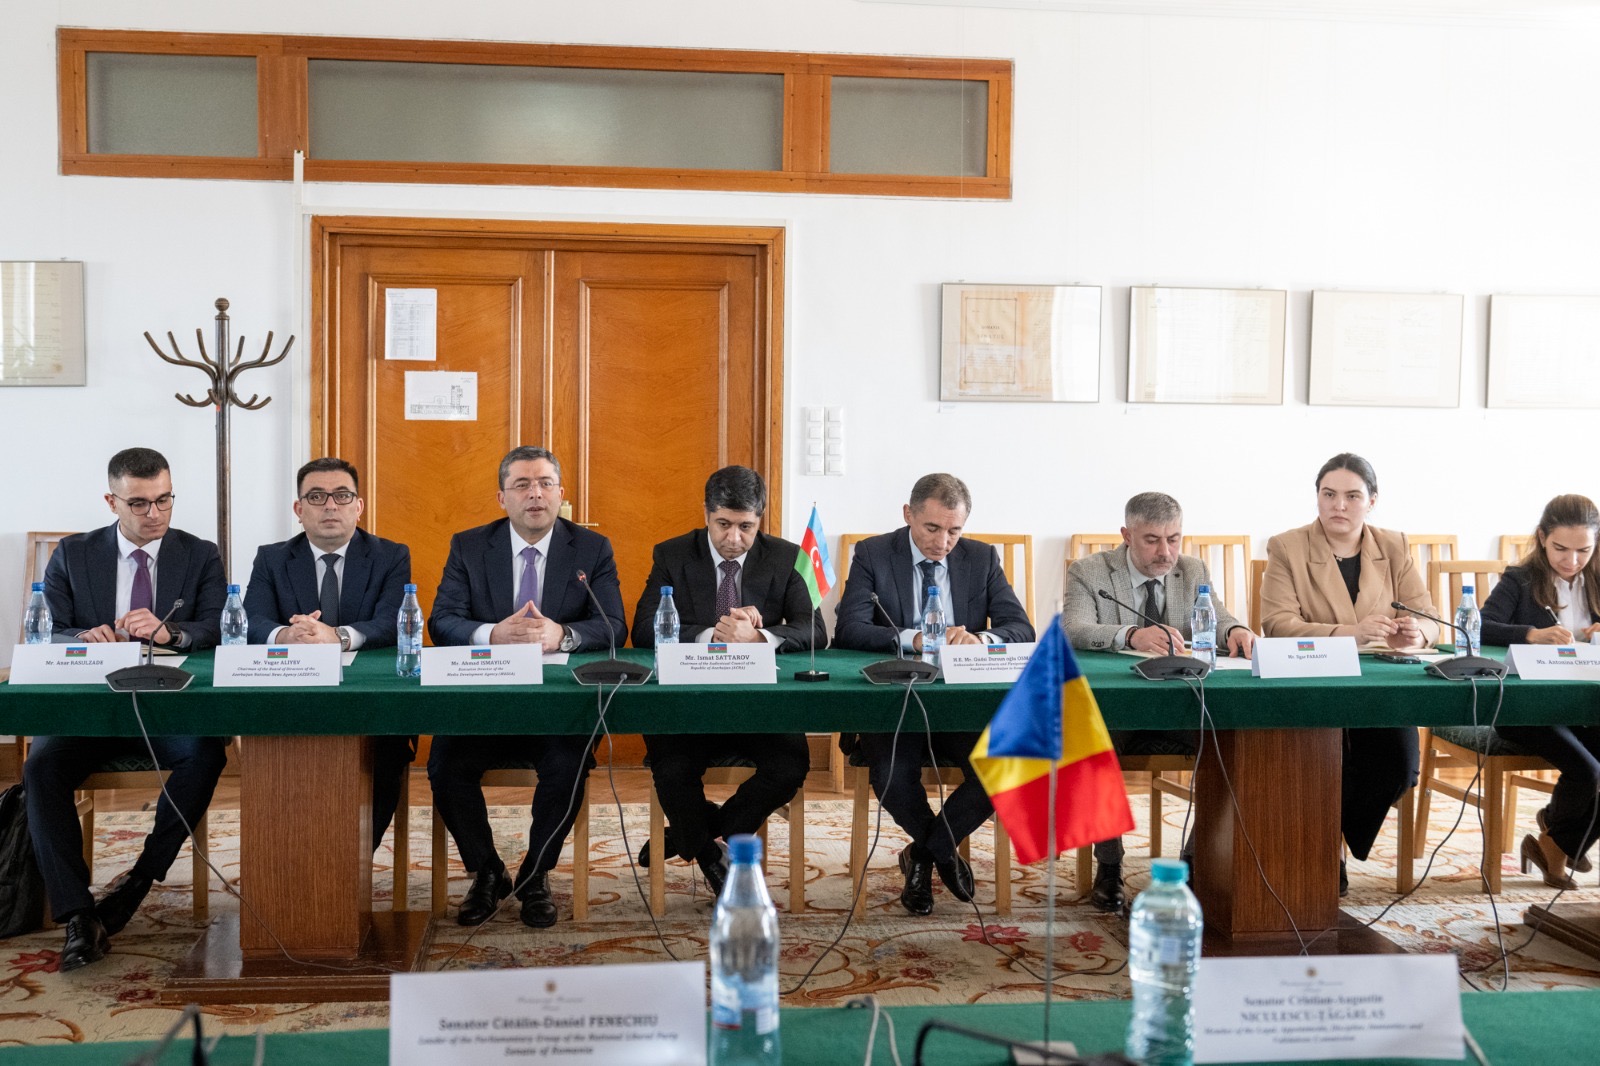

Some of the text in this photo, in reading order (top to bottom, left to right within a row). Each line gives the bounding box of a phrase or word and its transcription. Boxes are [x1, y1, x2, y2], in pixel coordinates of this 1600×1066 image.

[1243, 996, 1285, 1006] Senator
[438, 1017, 488, 1031] Senator
[588, 1013, 659, 1028] FENECHIU
